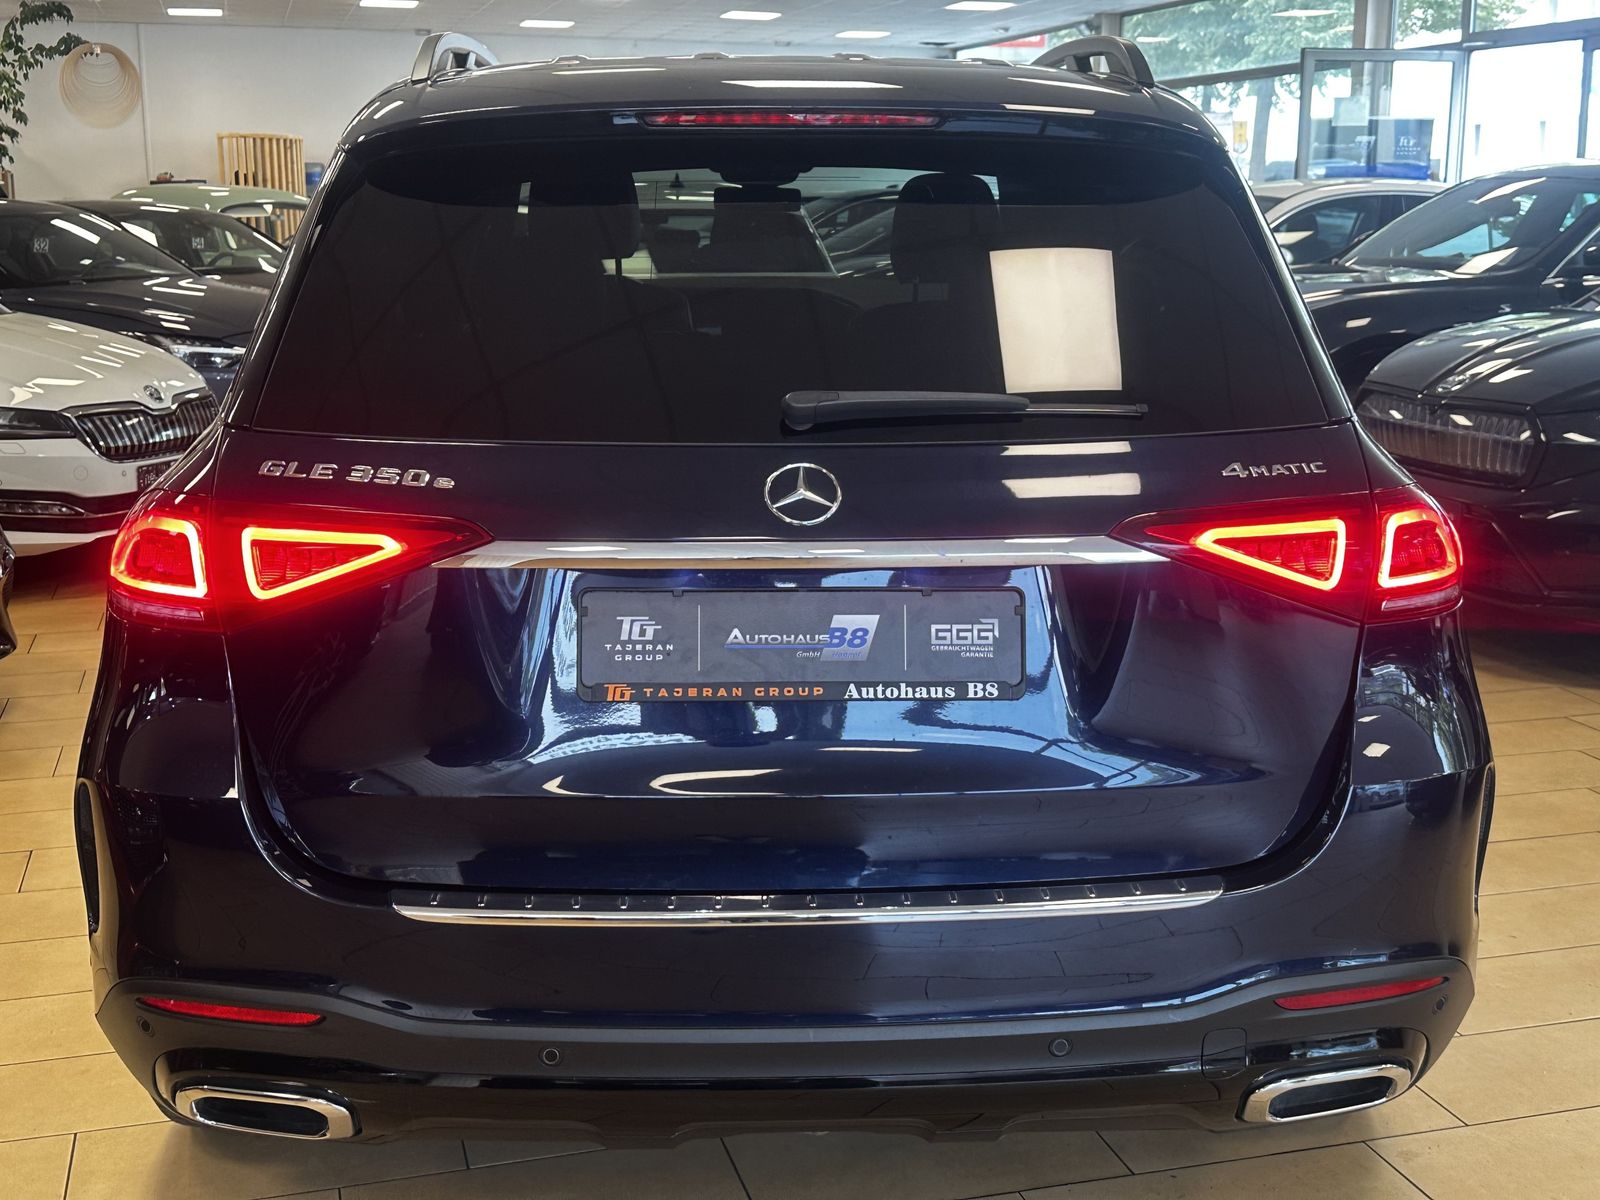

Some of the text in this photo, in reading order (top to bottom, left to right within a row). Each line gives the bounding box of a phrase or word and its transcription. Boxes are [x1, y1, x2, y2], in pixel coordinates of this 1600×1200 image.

[258, 460, 339, 480] GLE
[1221, 462, 1327, 478] 4MATIC
[726, 627, 870, 649] AUTOHAUS B8
[930, 624, 994, 645] GGG
[643, 687, 742, 697] TAJERAN
[754, 686, 825, 697] GROUP
[843, 682, 999, 699] Autohaus B8
